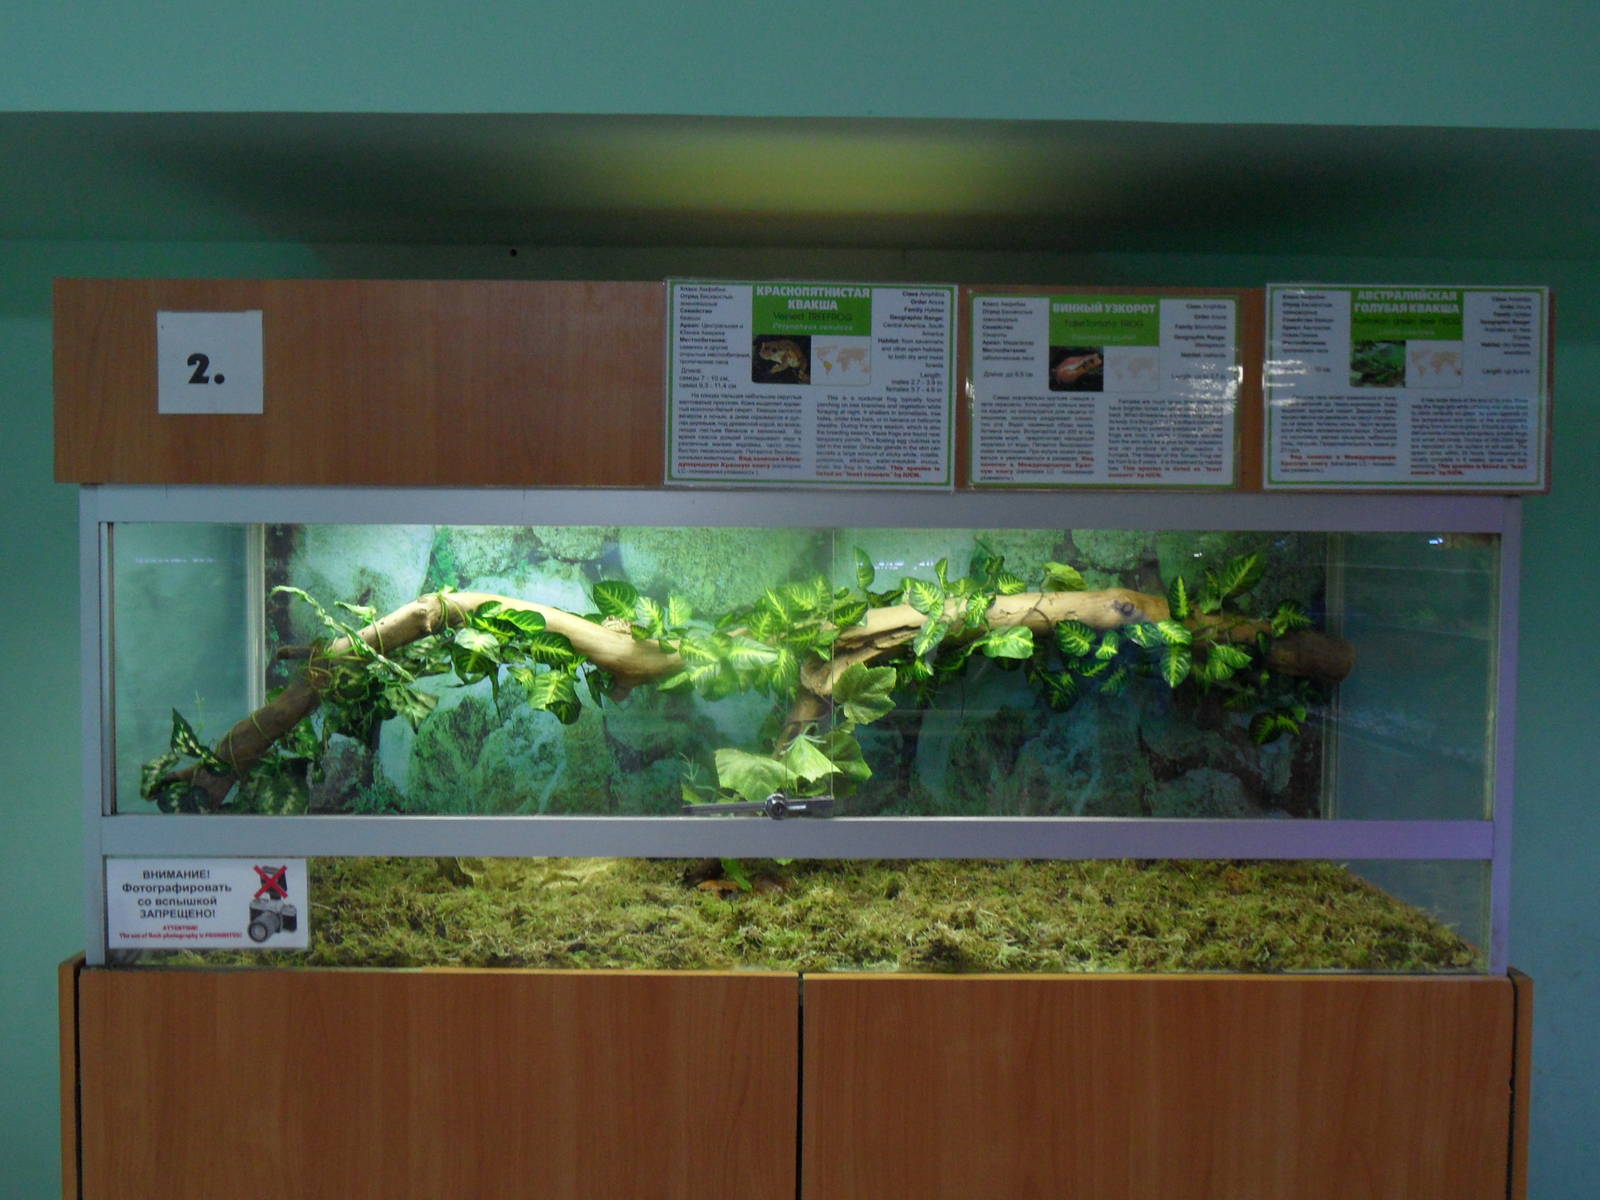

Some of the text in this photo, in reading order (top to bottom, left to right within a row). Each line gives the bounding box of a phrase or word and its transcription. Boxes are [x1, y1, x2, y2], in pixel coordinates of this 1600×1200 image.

[756, 286, 870, 298] КРАСНОПЯТНИСТАЯ
[1358, 290, 1457, 301] АВСТРАЛИЙСКАЯ
[788, 300, 838, 310] КВАКША
[1052, 302, 1156, 313] ВИННЫЙ УЗКОРОТ
[1354, 303, 1459, 313] ГОЛУБАЯ КВАКША
[187, 353, 225, 384] 2.
[142, 870, 210, 880] ВНИМАНИЕ!
[122, 883, 232, 894] Фотографировать
[155, 896, 217, 906] вспышкой
[140, 909, 216, 920] ЗАПРЕЩЕНО!
